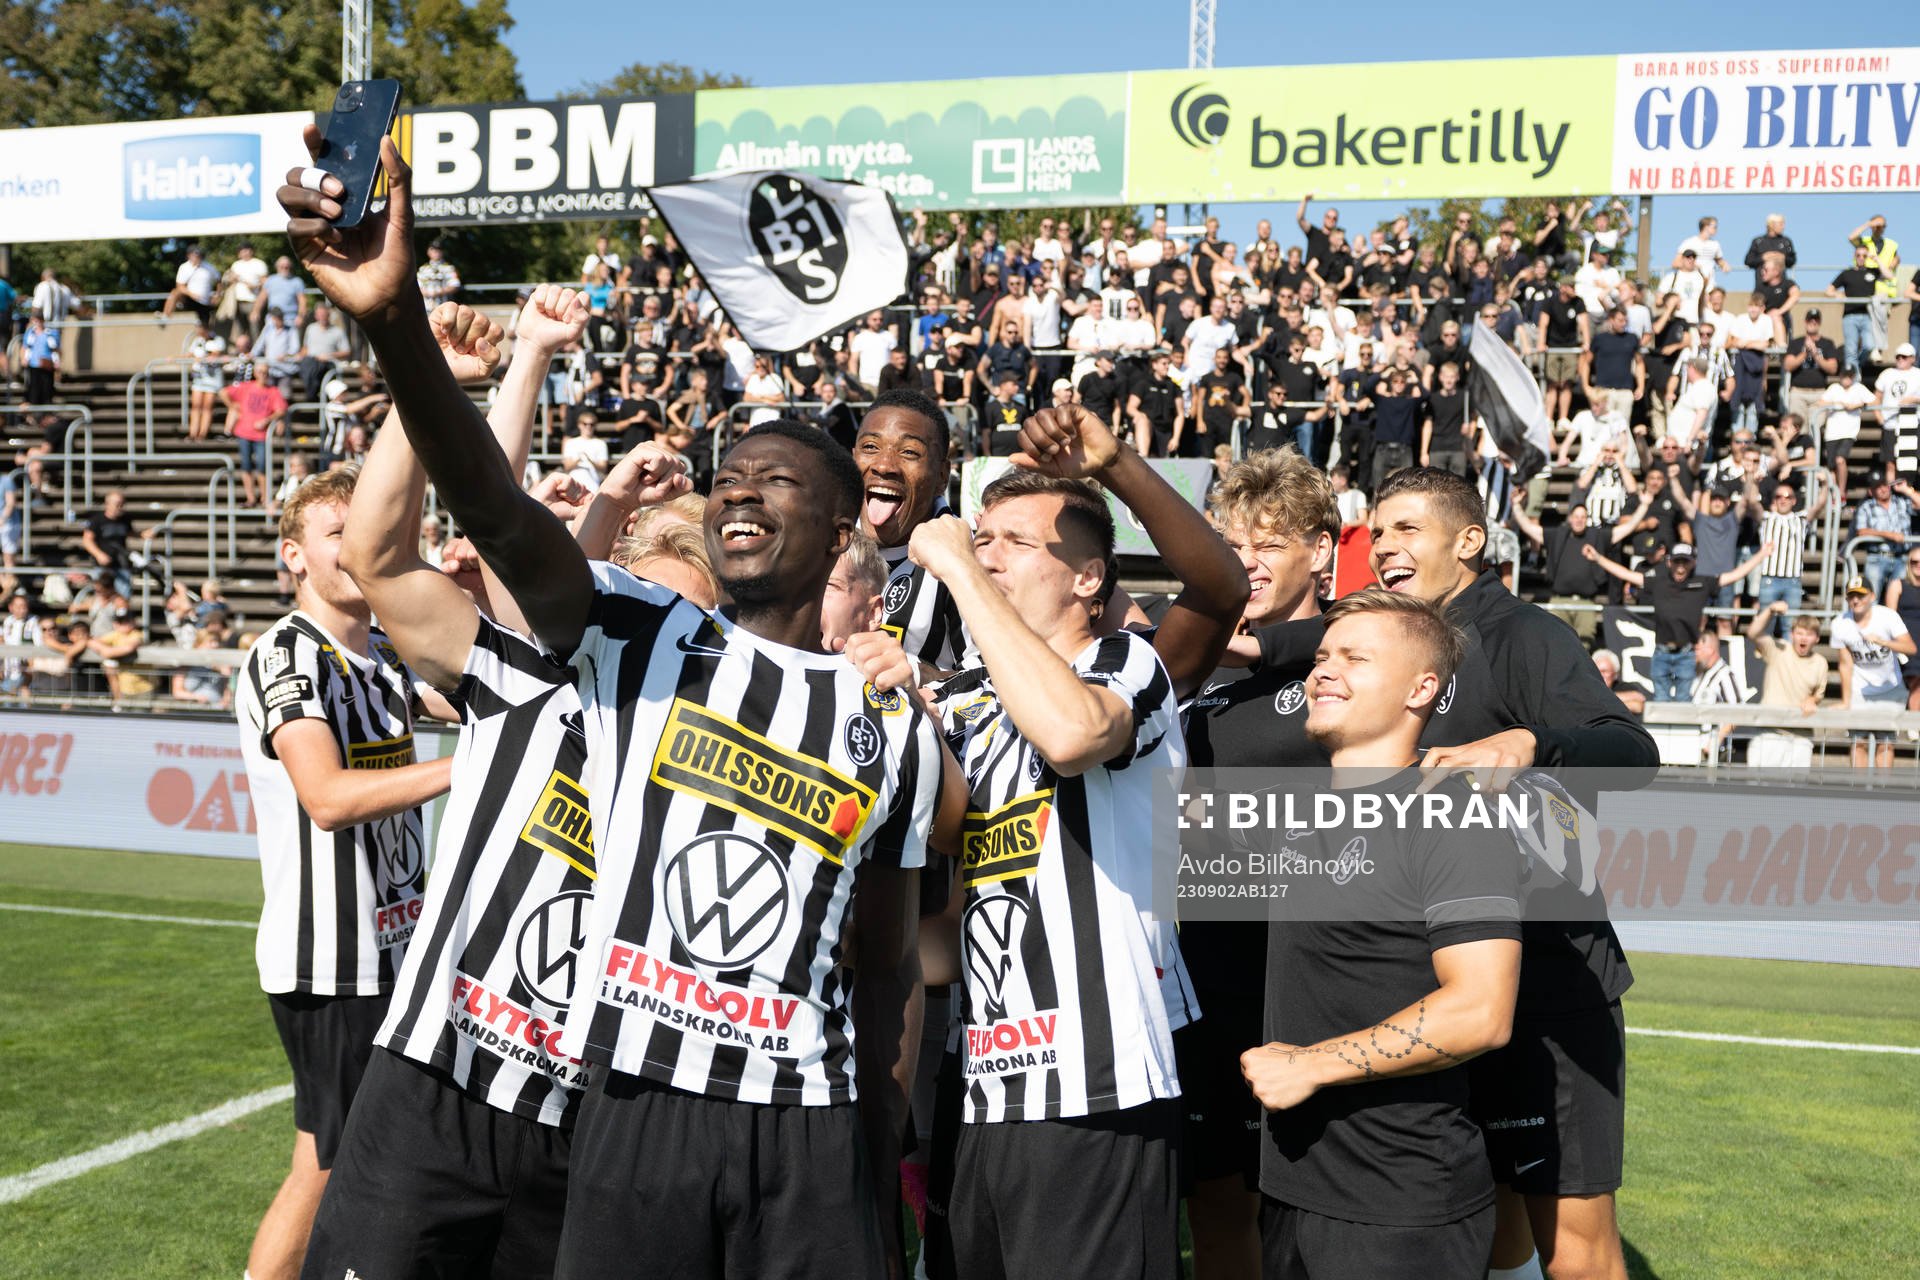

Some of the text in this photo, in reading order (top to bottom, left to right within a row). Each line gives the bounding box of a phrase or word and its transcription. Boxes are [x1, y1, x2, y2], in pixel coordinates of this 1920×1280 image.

[1634, 61, 1678, 77] BARA
[1725, 58, 1759, 75] OSS
[1778, 56, 1891, 74] SUPERFOAM!
[1634, 86, 1719, 151] GO
[411, 101, 656, 196] BBM
[715, 141, 820, 169] Allmän
[1027, 135, 1097, 155] LANDS
[1250, 108, 1572, 180] bakertilly
[1027, 153, 1101, 173] KRONA
[1628, 168, 1660, 189] NU
[1671, 163, 1735, 189] BÅDE
[1745, 161, 1776, 188] PÅ
[132, 156, 254, 201] Haldex
[1027, 173, 1072, 192] HEM
[468, 196, 518, 216] BYGG
[521, 196, 535, 213] &
[537, 192, 625, 214] MONTAGE
[668, 727, 836, 827] OHLSSONS
[606, 944, 799, 1031] FLYTGOLV
[613, 986, 755, 1048] LANDSKRONA
[760, 1035, 789, 1052] AB
[1041, 1049, 1056, 1065] AB
